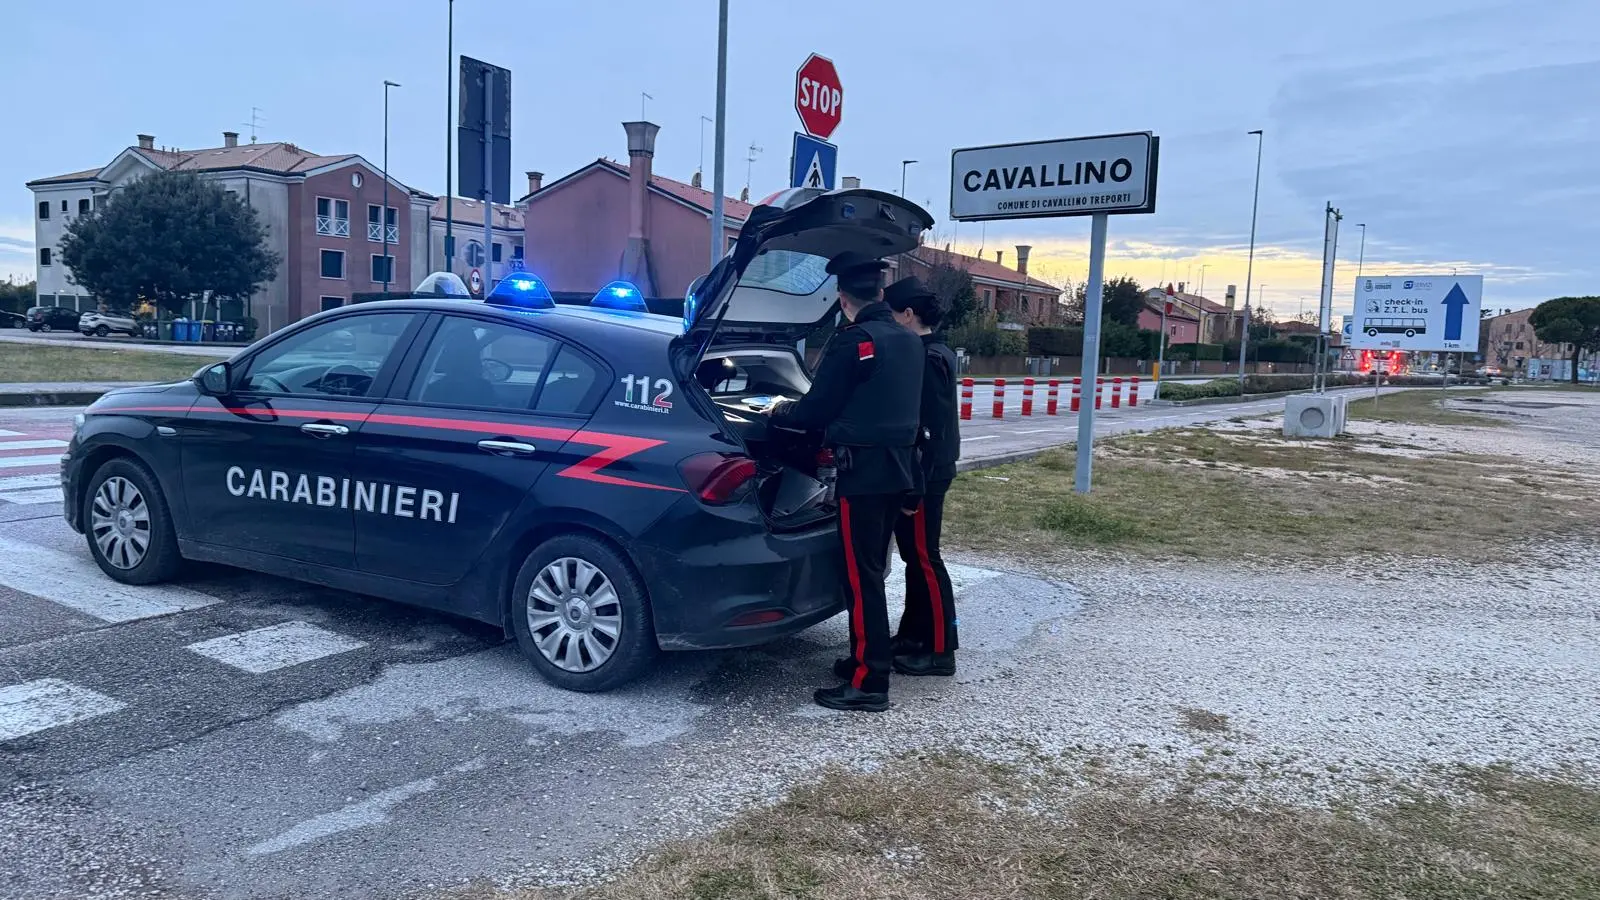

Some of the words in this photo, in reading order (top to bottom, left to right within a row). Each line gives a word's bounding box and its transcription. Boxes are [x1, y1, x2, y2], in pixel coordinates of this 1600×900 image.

[800, 77, 841, 117] STOP
[963, 158, 1133, 193] CAVALLINO
[997, 201, 1030, 210] COMUNE
[1031, 200, 1040, 208] DI
[1042, 197, 1088, 208] CAVALLINO
[1089, 193, 1131, 205] TREPORTI
[1384, 298, 1423, 306] check-in
[1384, 306, 1409, 314] Z.T.L.
[1411, 306, 1429, 314] bus
[621, 374, 673, 409] 112
[614, 400, 670, 414] www.carabinieri.it
[226, 465, 460, 524] CARABINIERI
